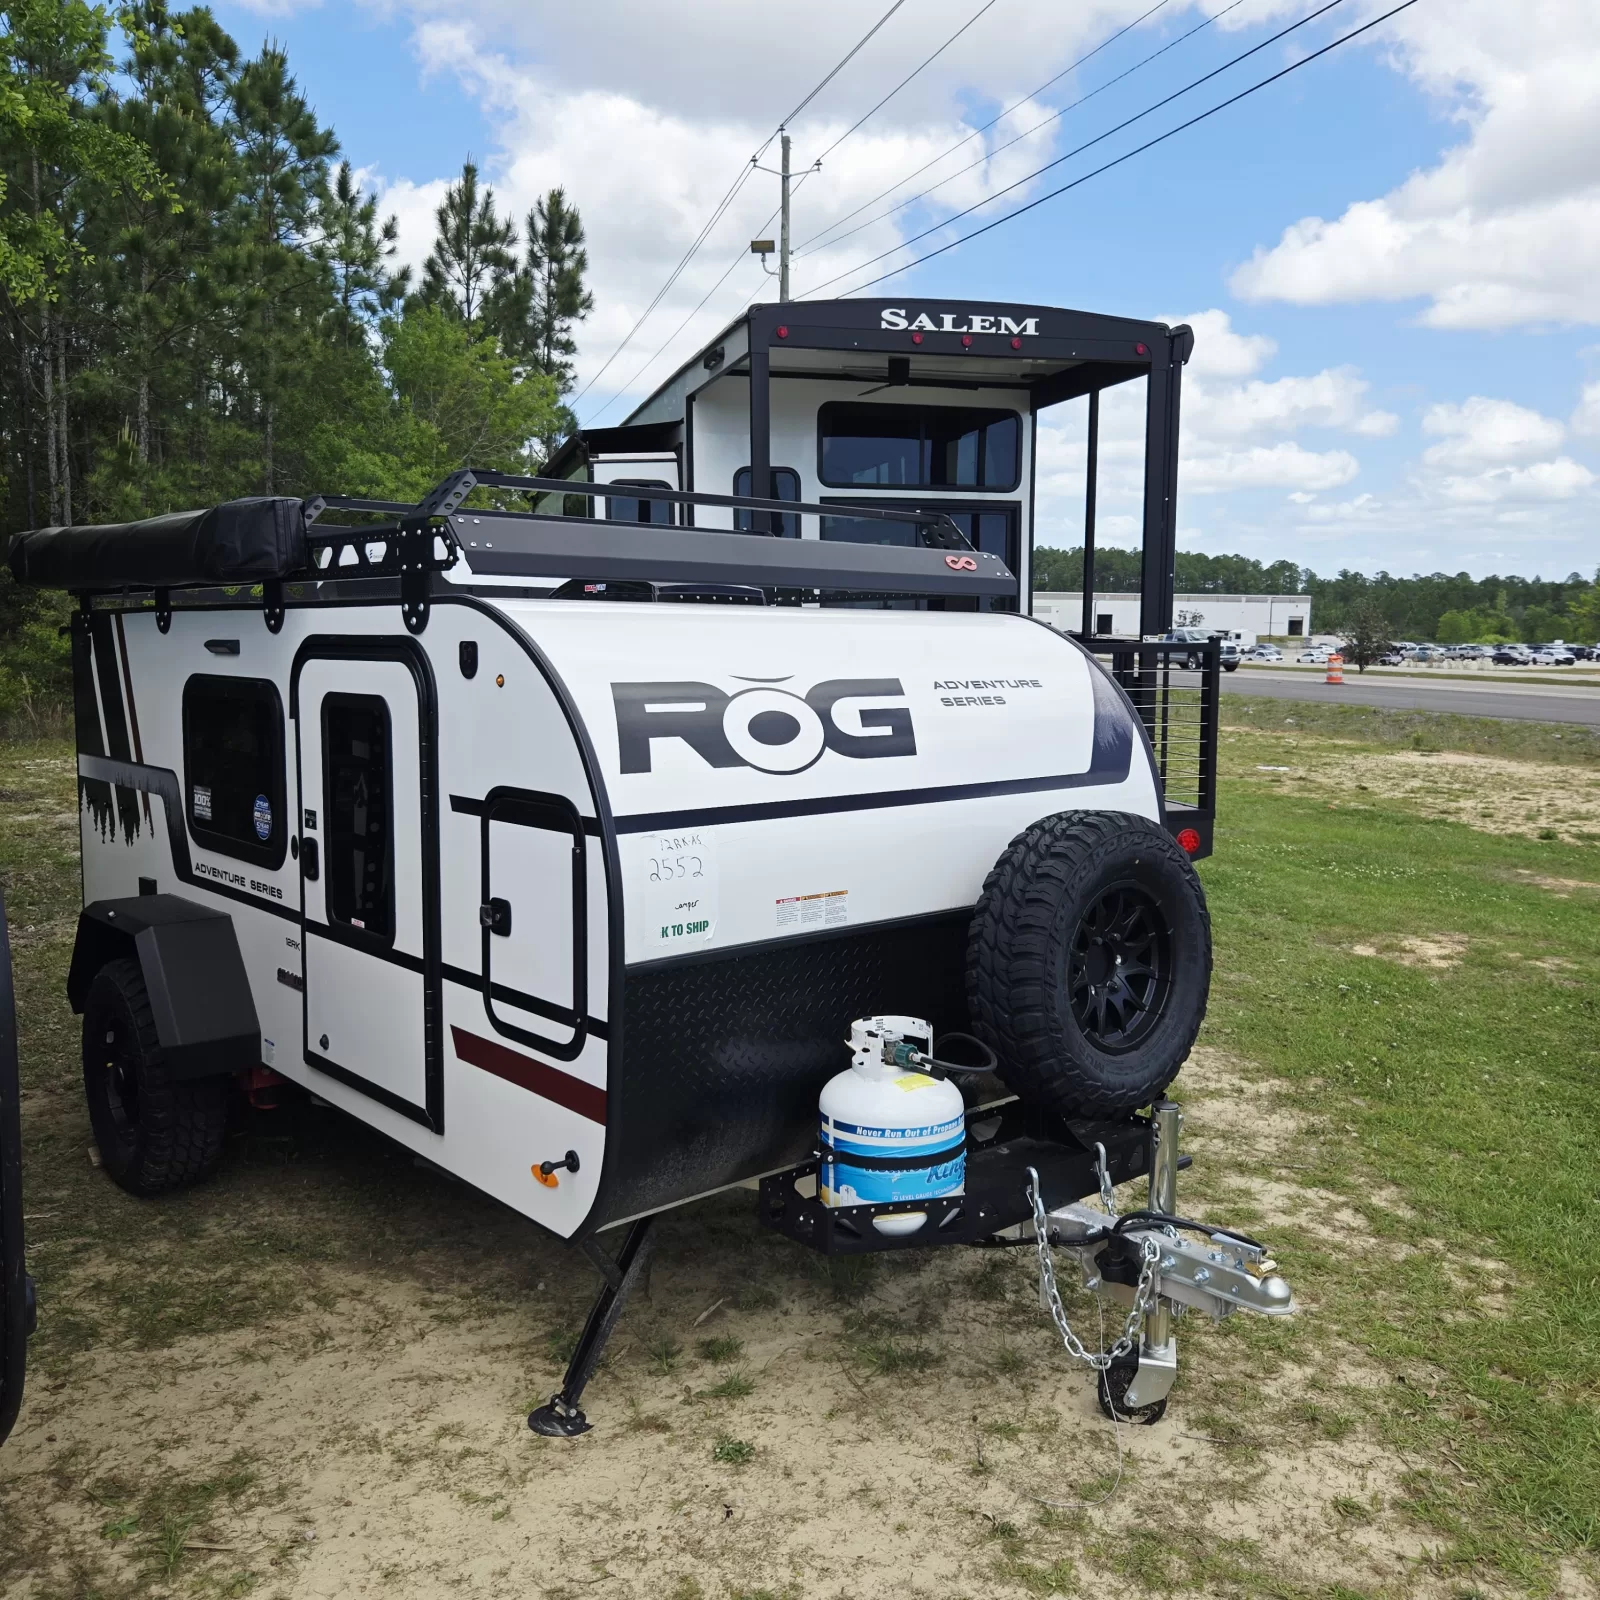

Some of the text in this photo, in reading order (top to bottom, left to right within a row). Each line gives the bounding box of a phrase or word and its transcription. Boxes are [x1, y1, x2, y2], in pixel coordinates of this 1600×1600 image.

[881, 308, 1039, 335] SALEM
[934, 680, 1043, 690] ADVENTURE
[940, 696, 1006, 707] SERIES
[610, 675, 917, 775] ROG
[194, 793, 211, 807] 100%
[650, 856, 704, 882] 2552
[195, 862, 283, 899] ADVENTURE SERIES
[671, 924, 684, 936] TO
[686, 920, 709, 934] SHIP
[286, 937, 301, 951] 12RK
[856, 1126, 882, 1137] Never
[884, 1128, 902, 1138] Run
[905, 1129, 920, 1138] Out
[922, 1126, 931, 1136] of
[932, 1121, 958, 1134] Propane
